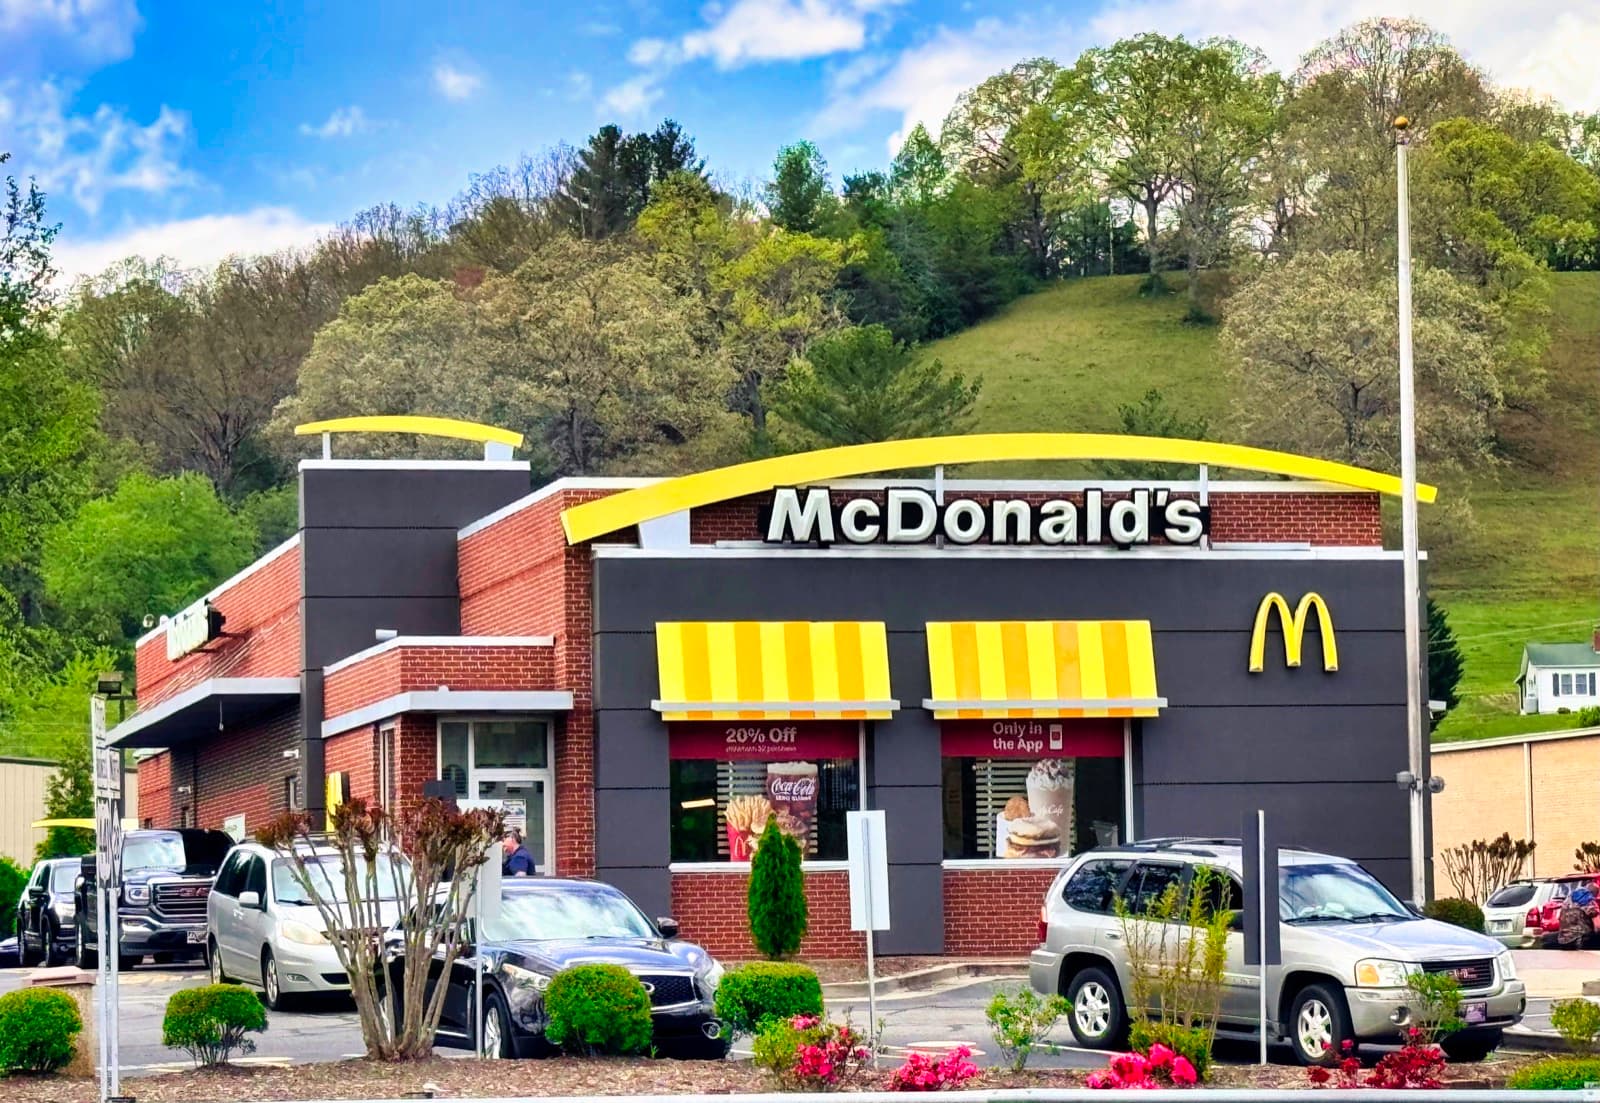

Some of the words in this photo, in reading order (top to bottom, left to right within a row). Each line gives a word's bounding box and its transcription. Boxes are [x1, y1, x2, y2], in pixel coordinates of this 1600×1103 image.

[766, 488, 1203, 545] McDonald's
[726, 728, 766, 743] 20%
[769, 727, 797, 743] Off
[993, 722, 1026, 738] Only
[1029, 721, 1043, 735] in
[993, 738, 1014, 750] the
[1017, 738, 1043, 753] App
